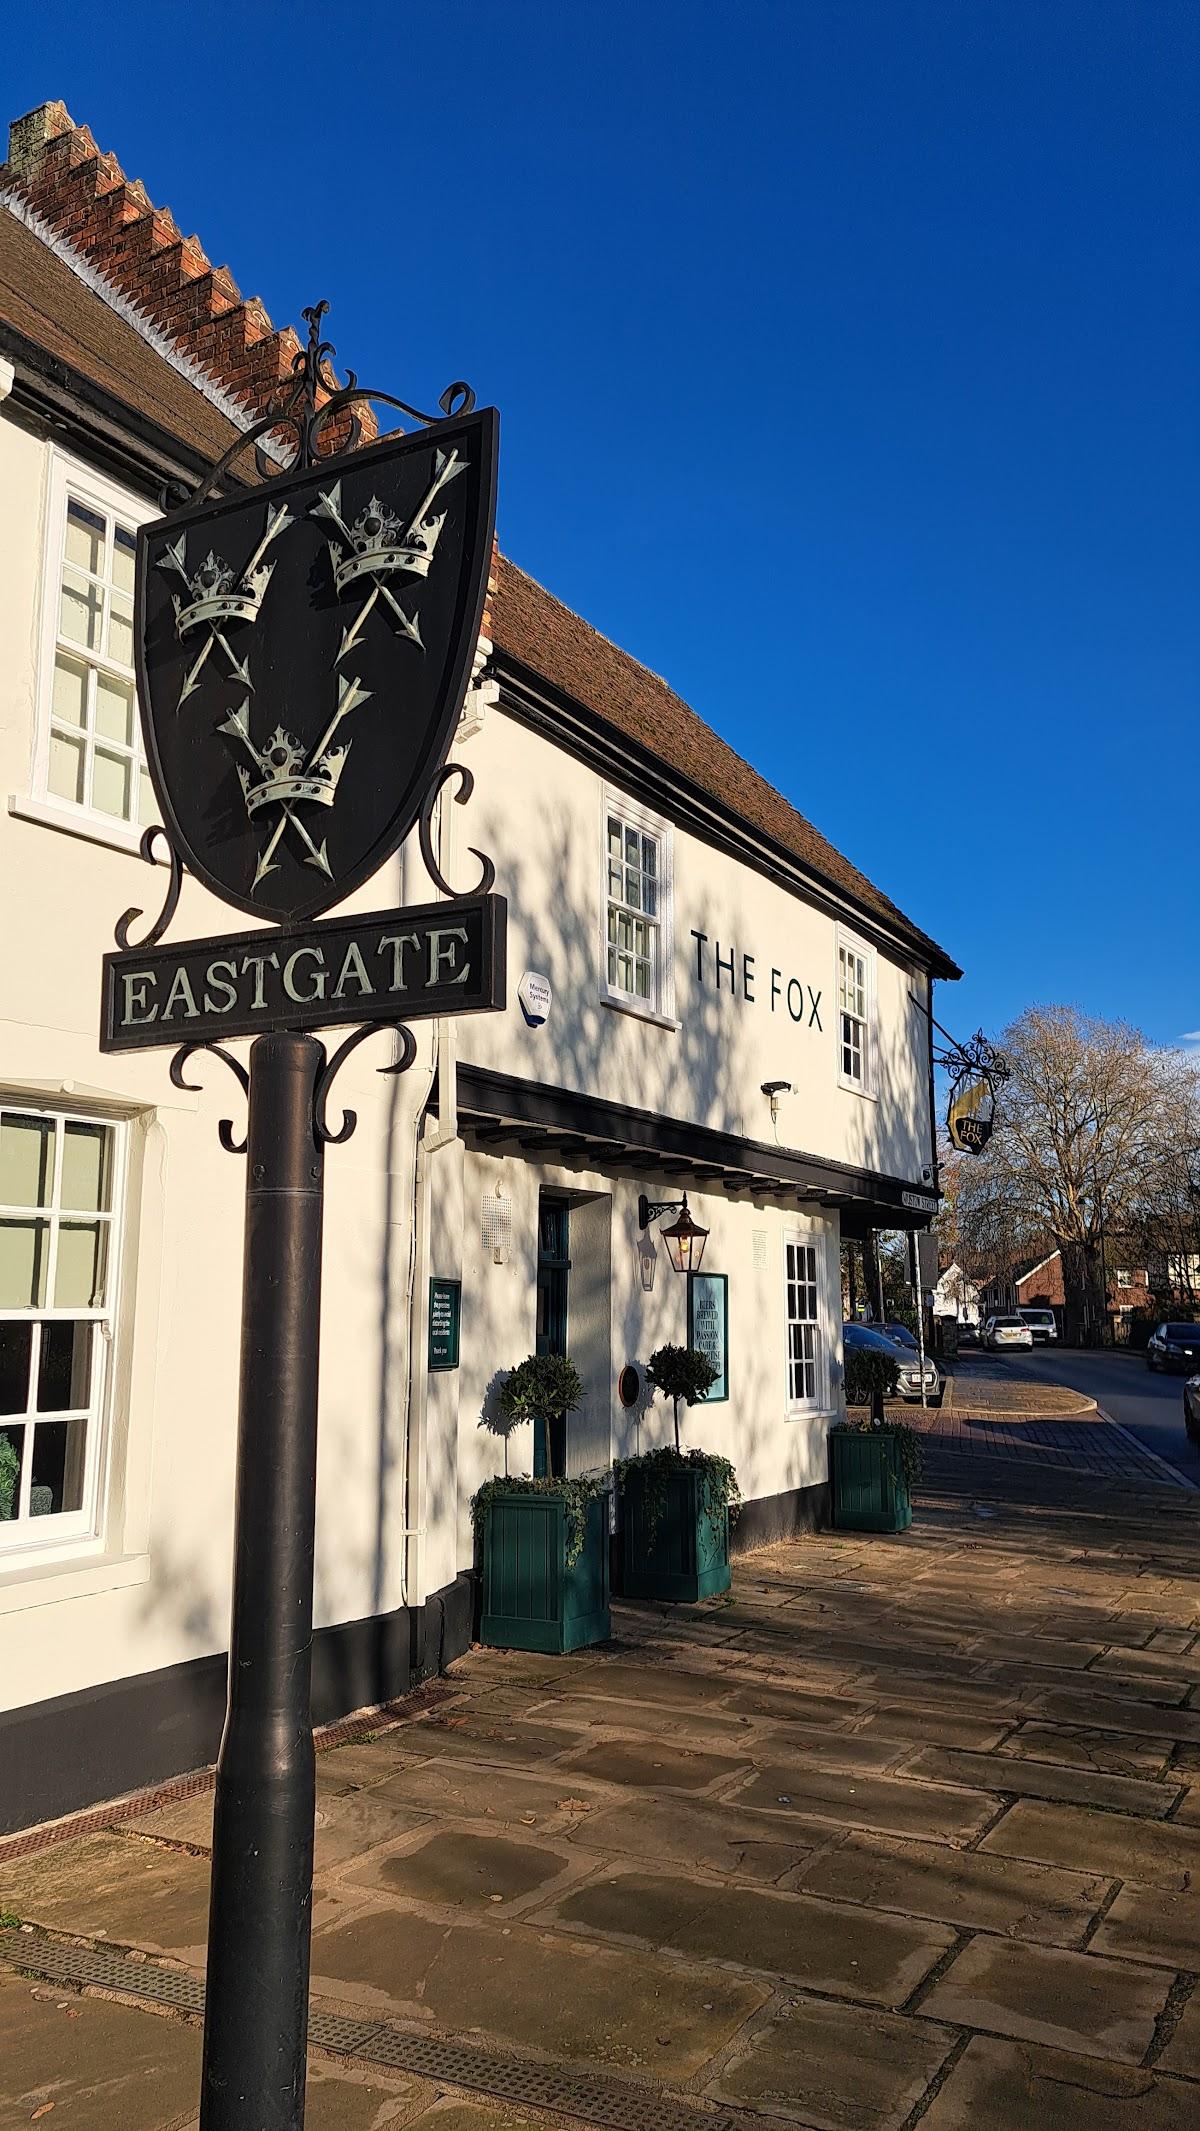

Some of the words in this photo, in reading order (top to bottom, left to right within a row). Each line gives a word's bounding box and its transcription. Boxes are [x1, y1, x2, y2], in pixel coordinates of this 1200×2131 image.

[120, 927, 470, 1026] EASTGATE
[690, 929, 755, 1003] THE
[771, 967, 823, 1033] FOX
[529, 992, 549, 1003] Systems
[962, 1119, 983, 1135] THE
[960, 1130, 983, 1145] FOX
[700, 1301, 715, 1309] BEERS
[697, 1311, 718, 1320] BREWED
[700, 1321, 714, 1330] WITH
[697, 1331, 718, 1340] PASSION
[699, 1341, 711, 1350] CARE
